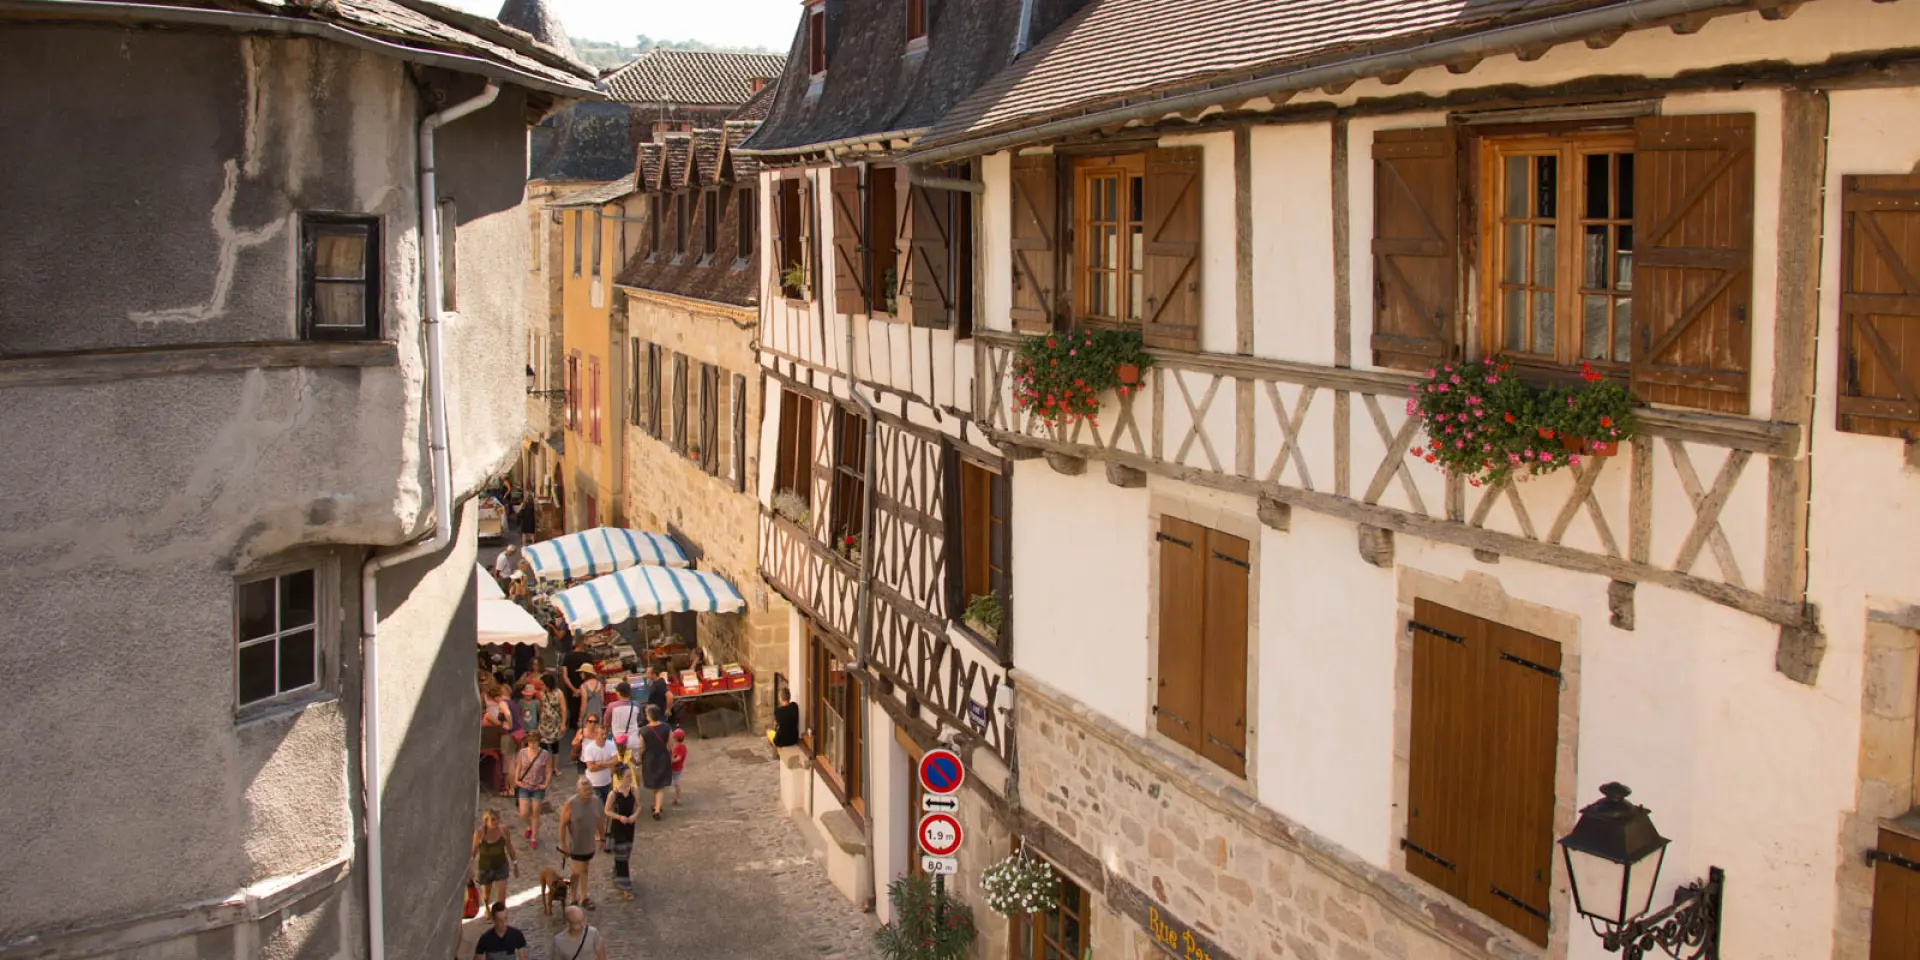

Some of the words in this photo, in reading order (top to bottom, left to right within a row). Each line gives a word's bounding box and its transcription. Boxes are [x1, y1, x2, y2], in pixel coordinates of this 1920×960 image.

[945, 833, 954, 841] m
[928, 861, 943, 870] 80
[1148, 906, 1177, 949] Rue
